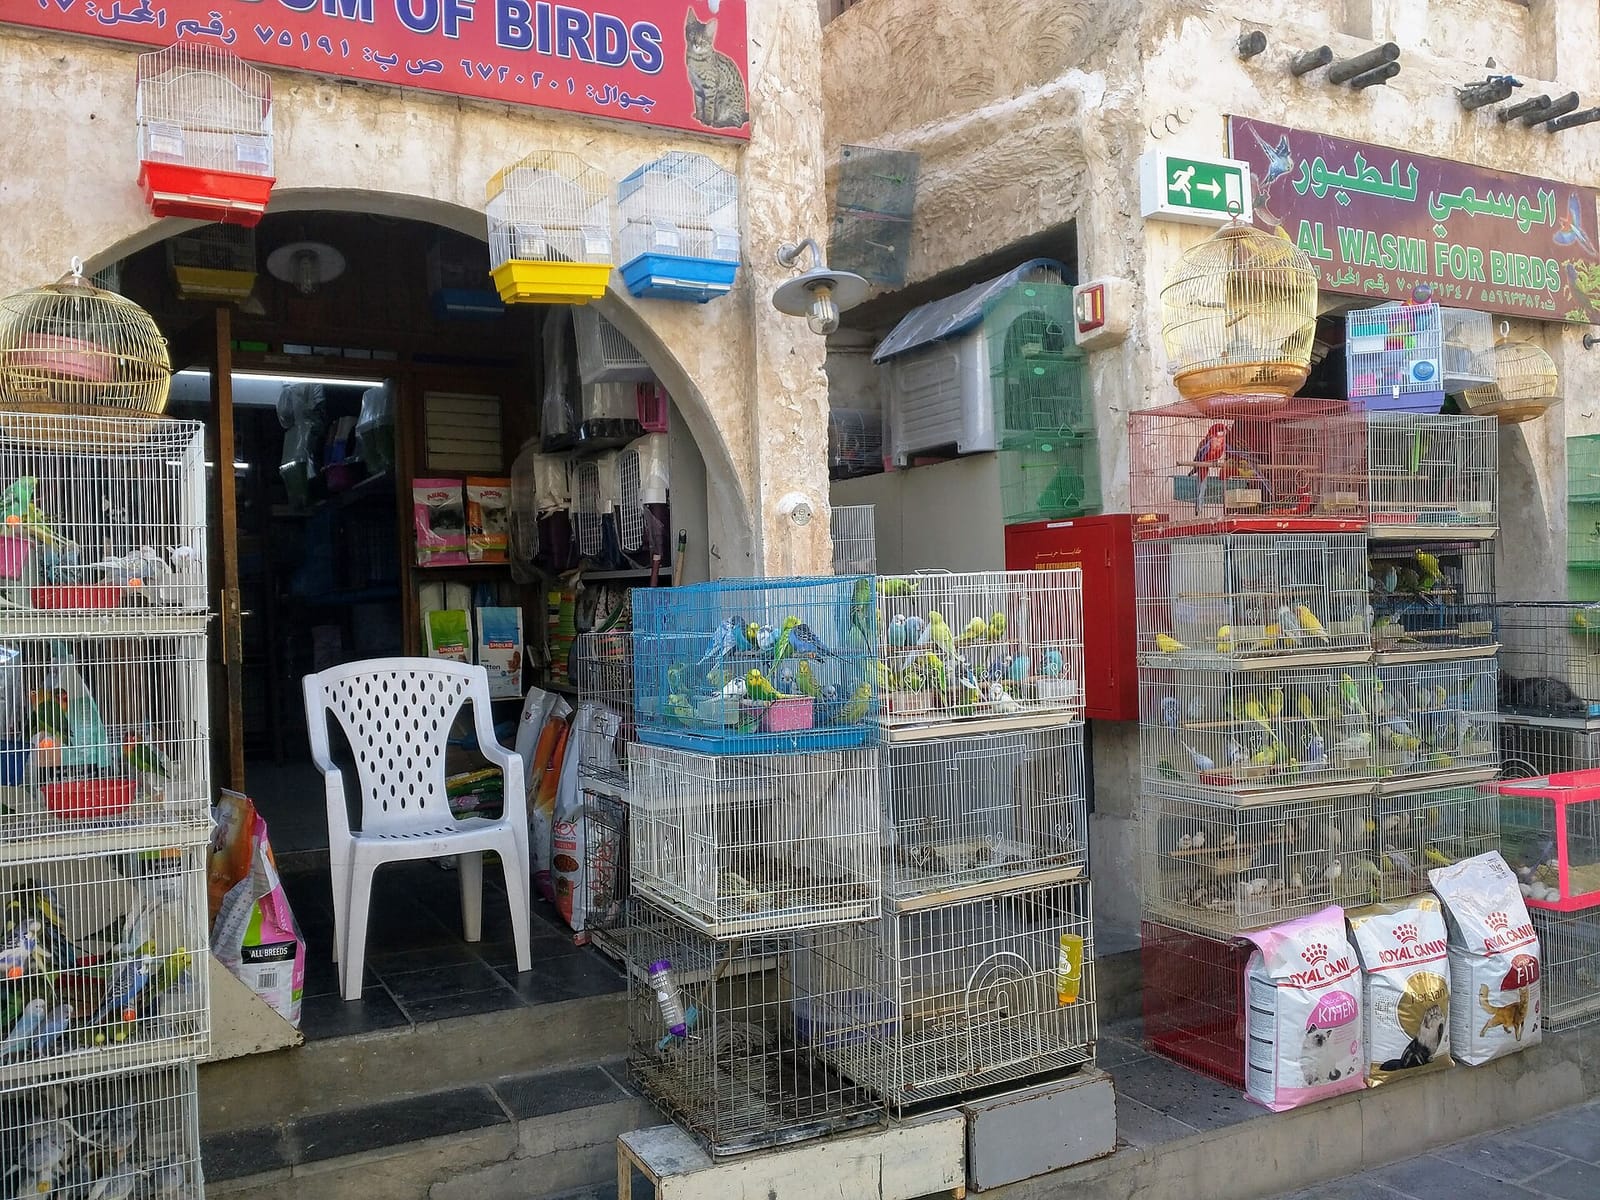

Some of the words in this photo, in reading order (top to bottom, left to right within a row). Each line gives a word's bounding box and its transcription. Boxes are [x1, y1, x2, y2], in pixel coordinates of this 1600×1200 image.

[176, 11, 237, 44] رقم
[254, 23, 350, 57] ٧٥١٩١
[395, 0, 475, 38] OF
[496, 0, 664, 74] BIRDS
[1292, 151, 1419, 206] للطيور
[1427, 186, 1558, 236] الوسمي
[1296, 219, 1333, 260] AL
[1337, 226, 1428, 275] WASMI
[1434, 239, 1486, 283] FOR
[1491, 249, 1561, 293] BIRDS
[1363, 273, 1390, 294] رقم
[250, 949, 263, 958] ALL
[264, 947, 288, 957] BREEDS
[1324, 957, 1350, 977] CANI
[1379, 946, 1414, 963] ROYAL
[1517, 959, 1535, 984] FIT
[1318, 999, 1355, 1023] KITTEN
